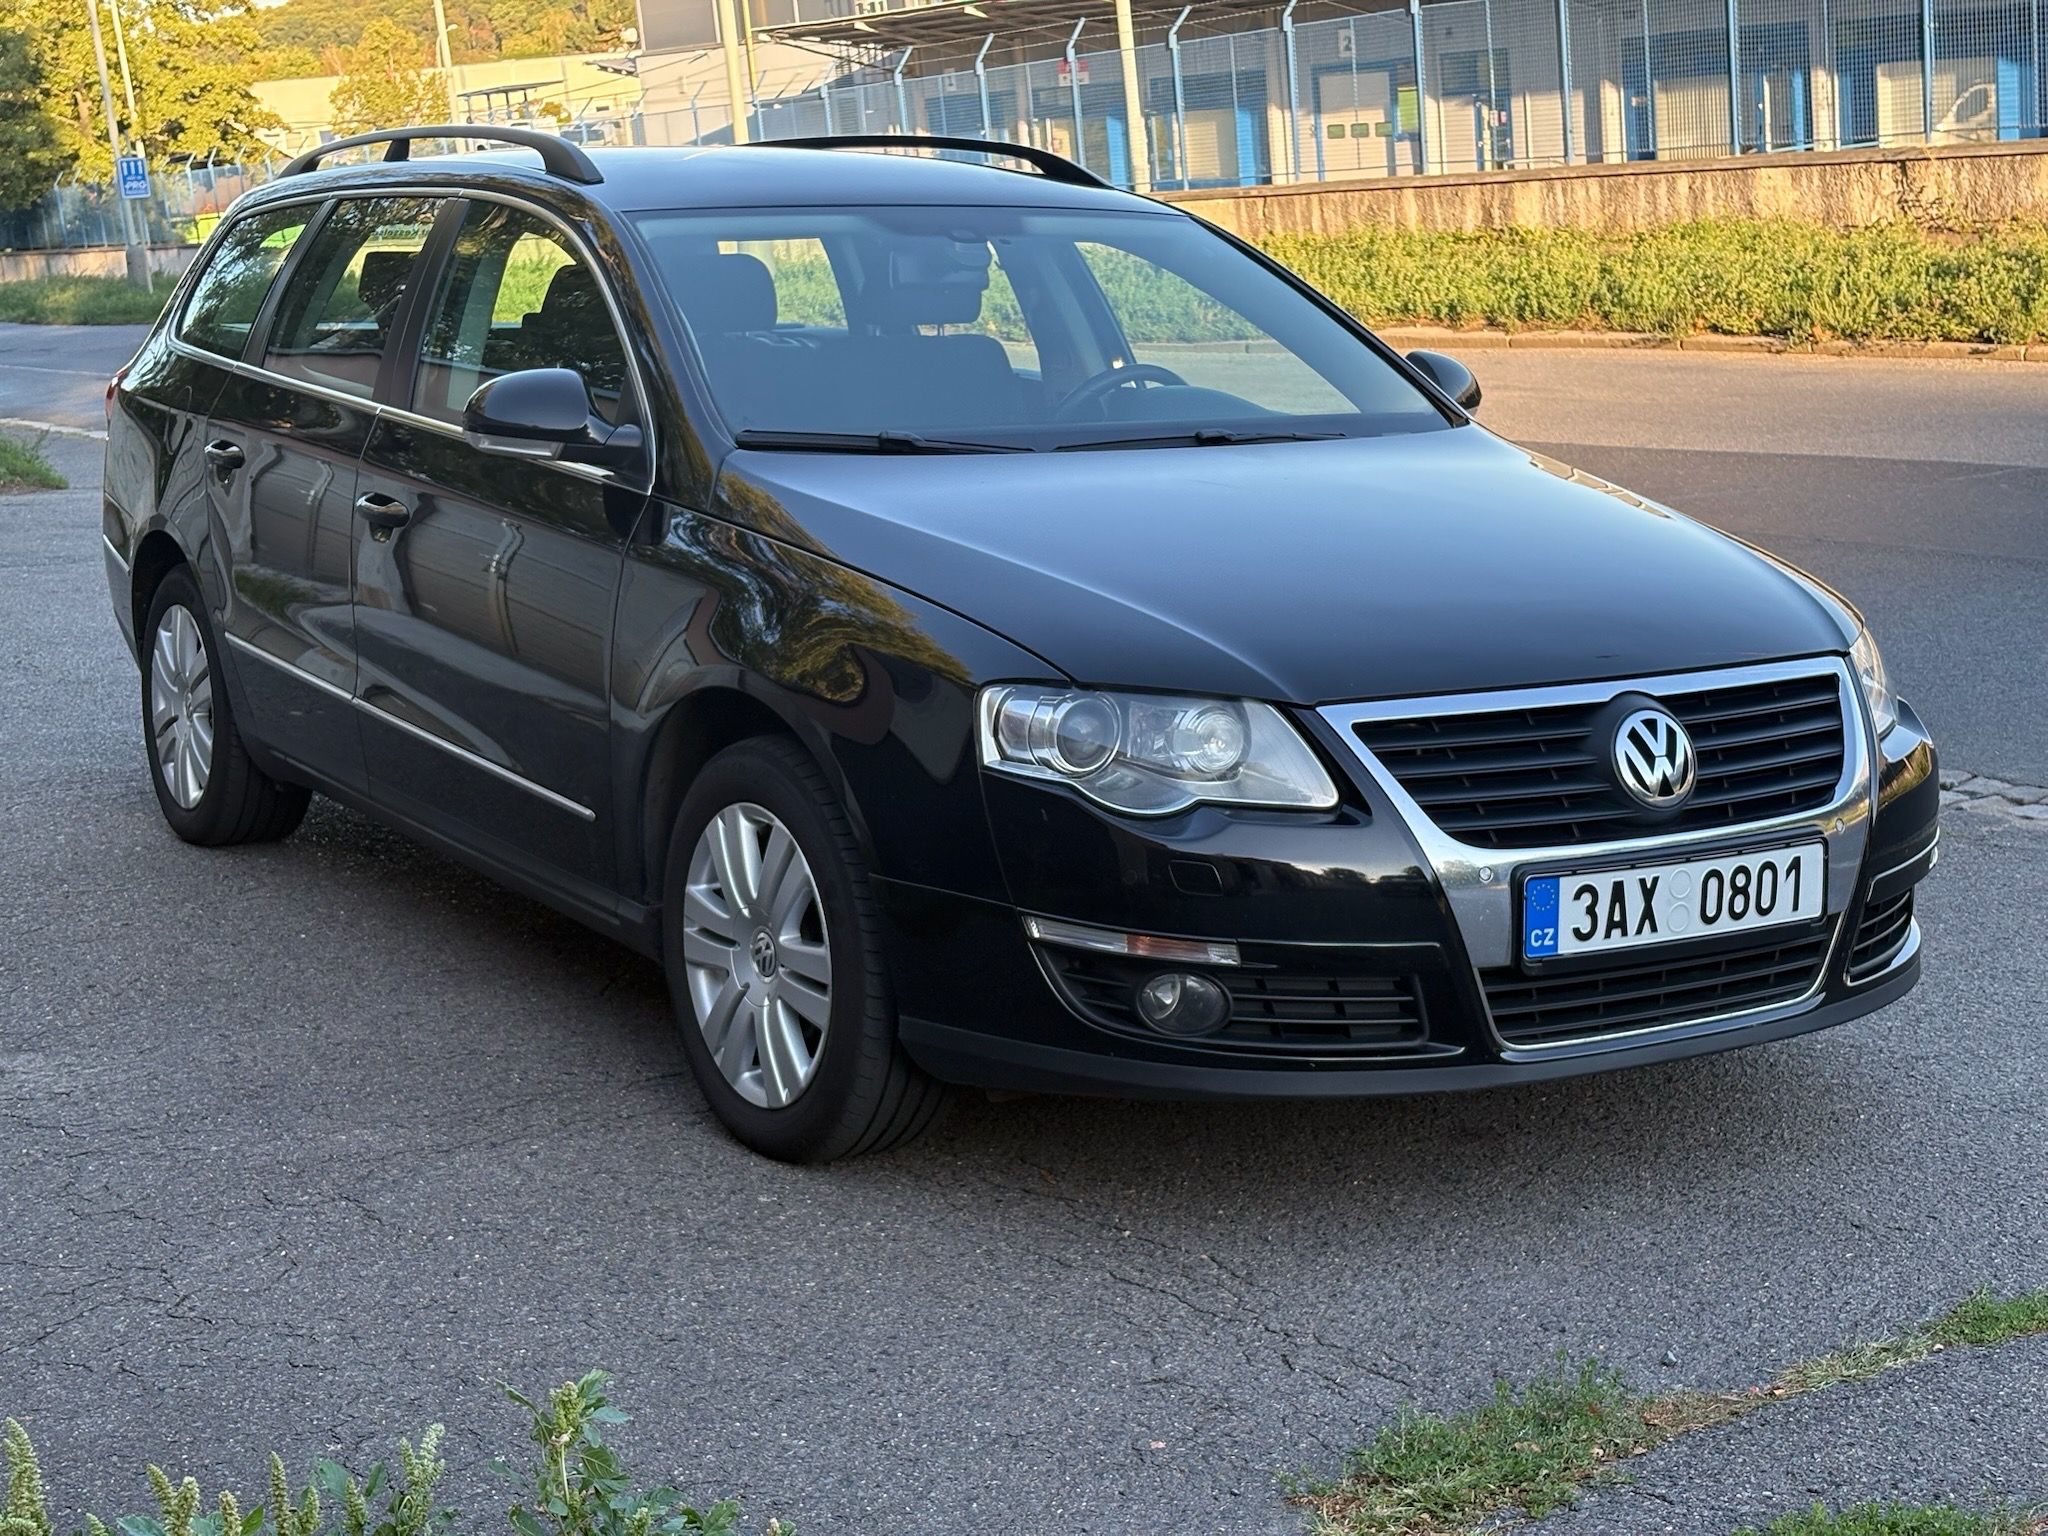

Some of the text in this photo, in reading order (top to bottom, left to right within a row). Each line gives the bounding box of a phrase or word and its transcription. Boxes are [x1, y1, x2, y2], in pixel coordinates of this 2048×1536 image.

[1615, 710, 1695, 807] VW
[1530, 928, 1554, 948] CZ
[1572, 855, 1801, 942] 3AX 0801
